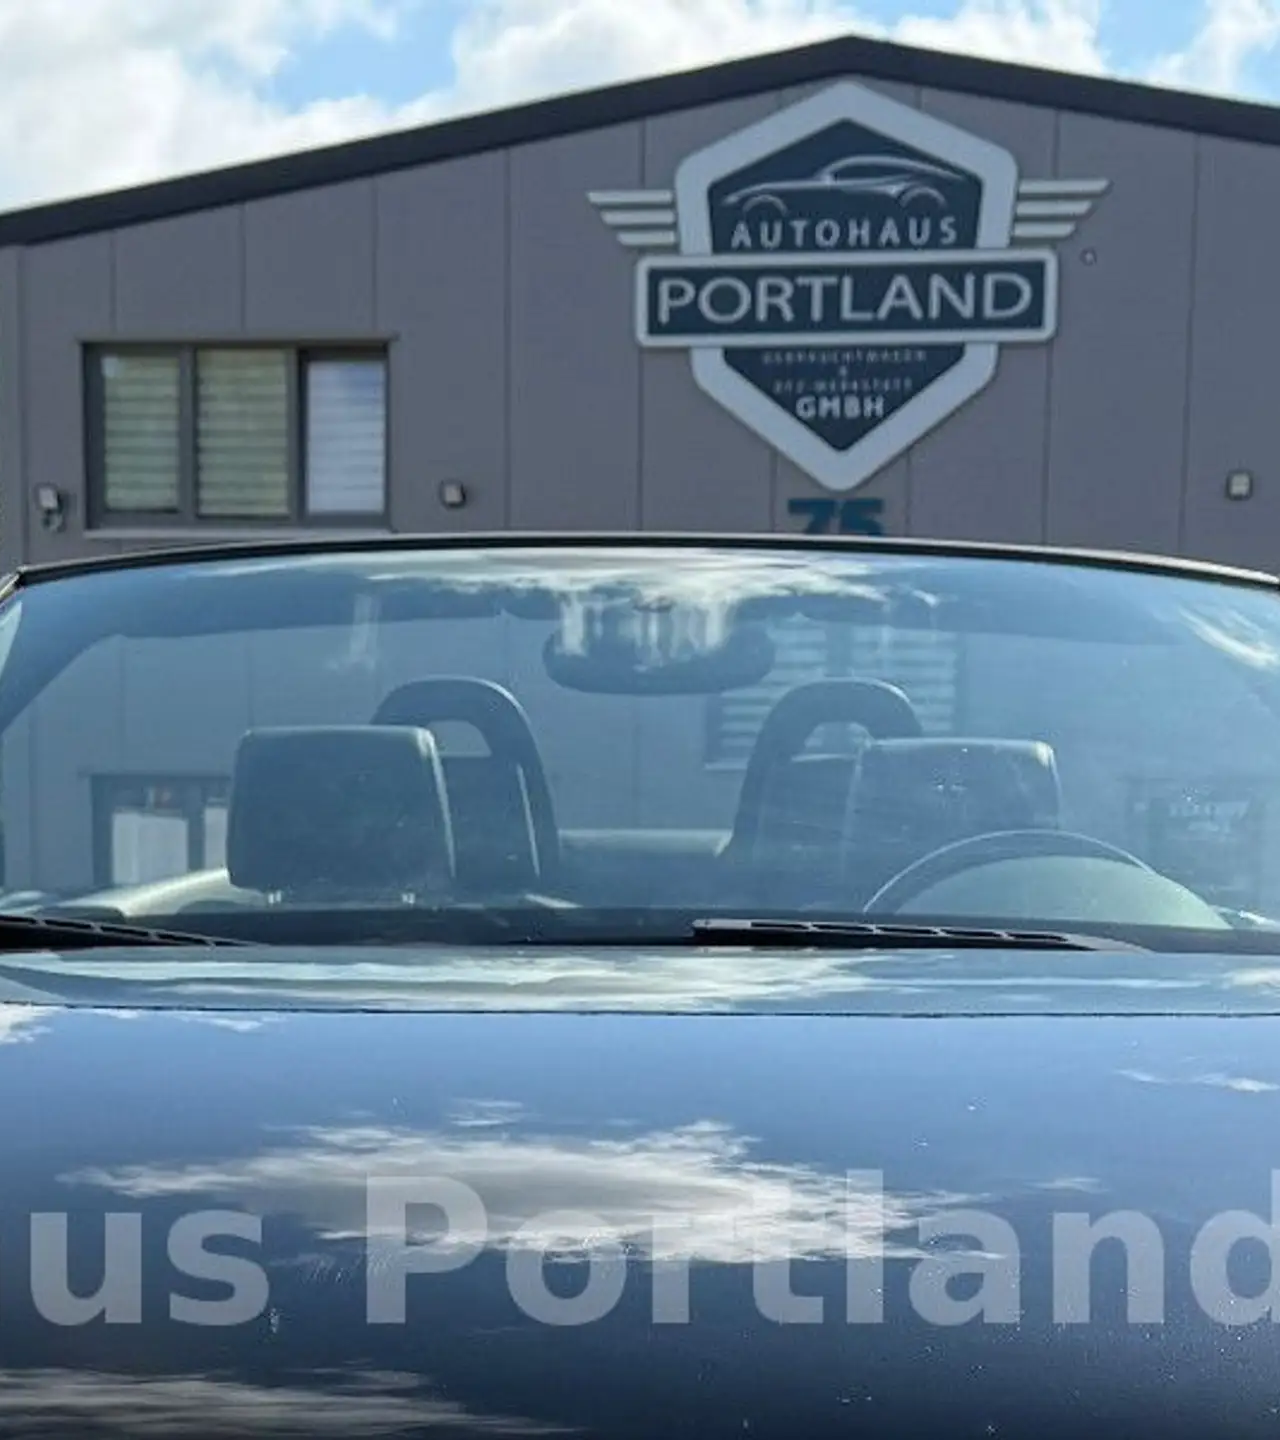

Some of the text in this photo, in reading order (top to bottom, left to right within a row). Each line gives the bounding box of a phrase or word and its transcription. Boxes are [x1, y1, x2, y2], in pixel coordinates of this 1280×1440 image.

[731, 217, 958, 248] AUTOHAUS
[657, 272, 1032, 325] PORTLAND
[795, 394, 885, 420] GMBH
